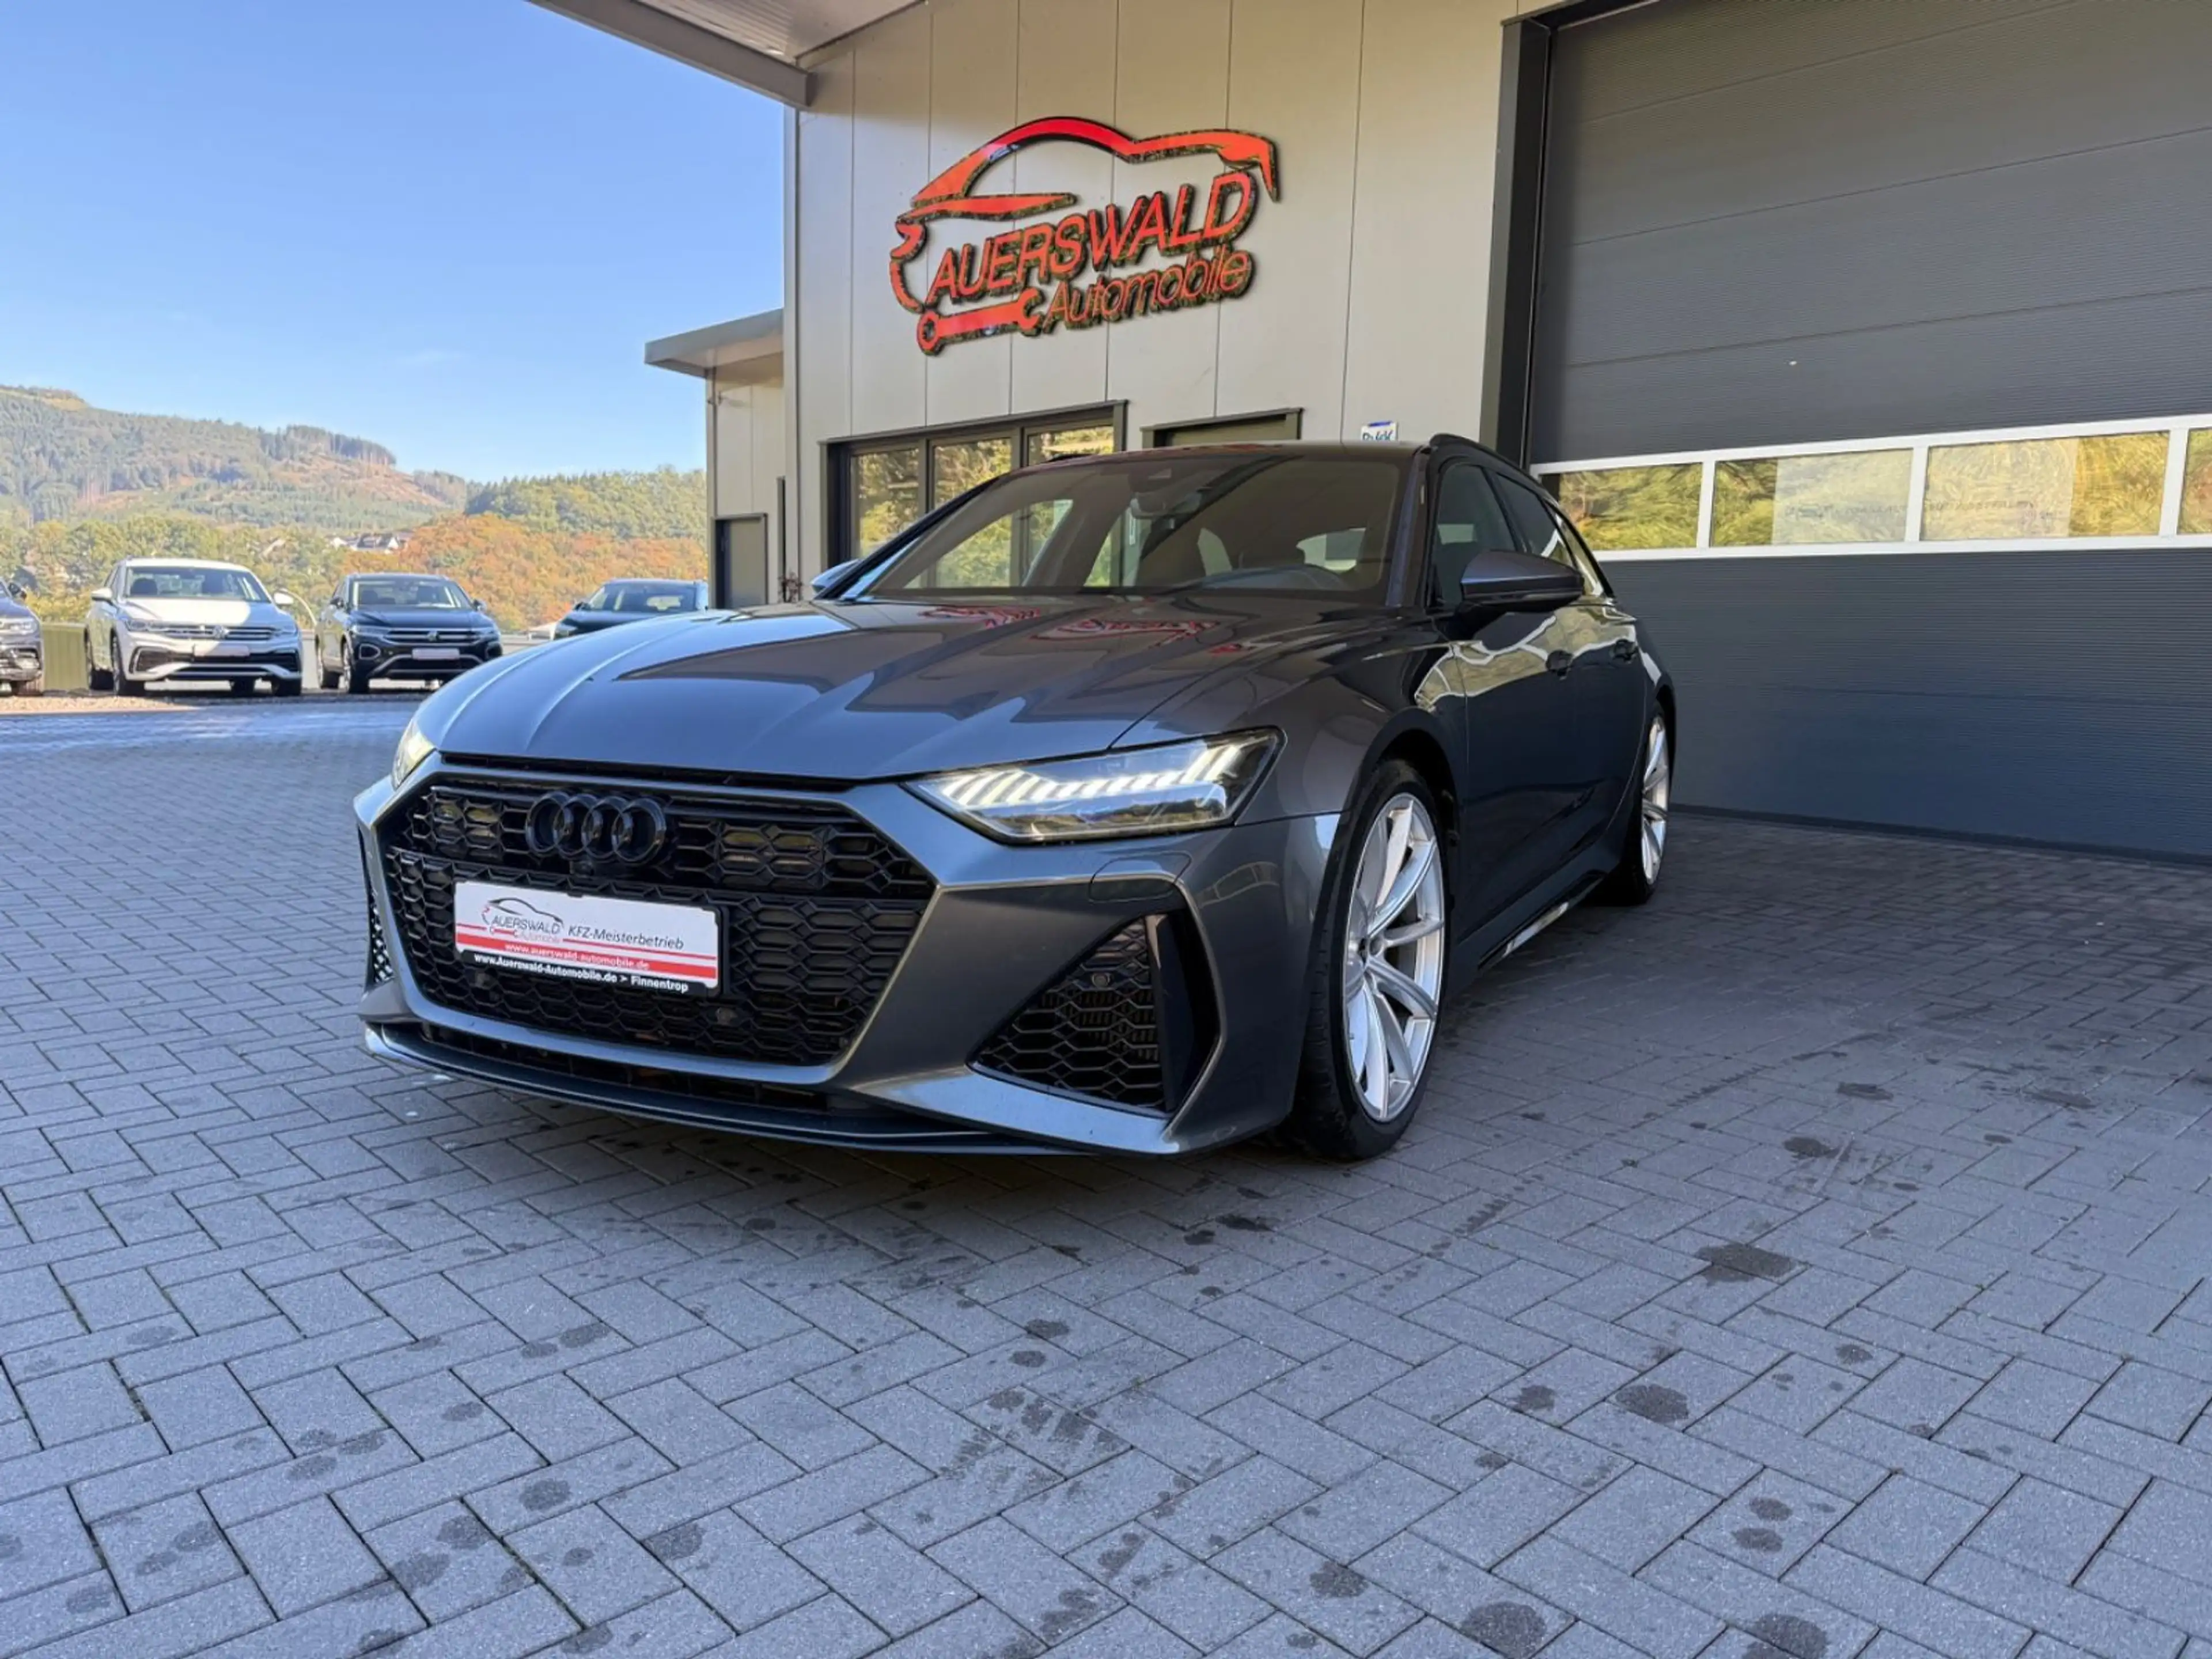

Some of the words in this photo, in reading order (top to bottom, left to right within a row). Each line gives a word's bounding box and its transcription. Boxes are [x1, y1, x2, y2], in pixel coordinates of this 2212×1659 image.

[925, 169, 1257, 305] AUERSWALD
[1044, 245, 1253, 333] Automobile
[492, 915, 561, 934] AUERSWALD
[568, 925, 684, 950] KFZ-Meisterbetrieb
[474, 953, 618, 982] www.Auerswald-Automobile.de
[631, 975, 689, 994] Finnentrop
[505, 944, 650, 970] www.auerswald-automobile.de
